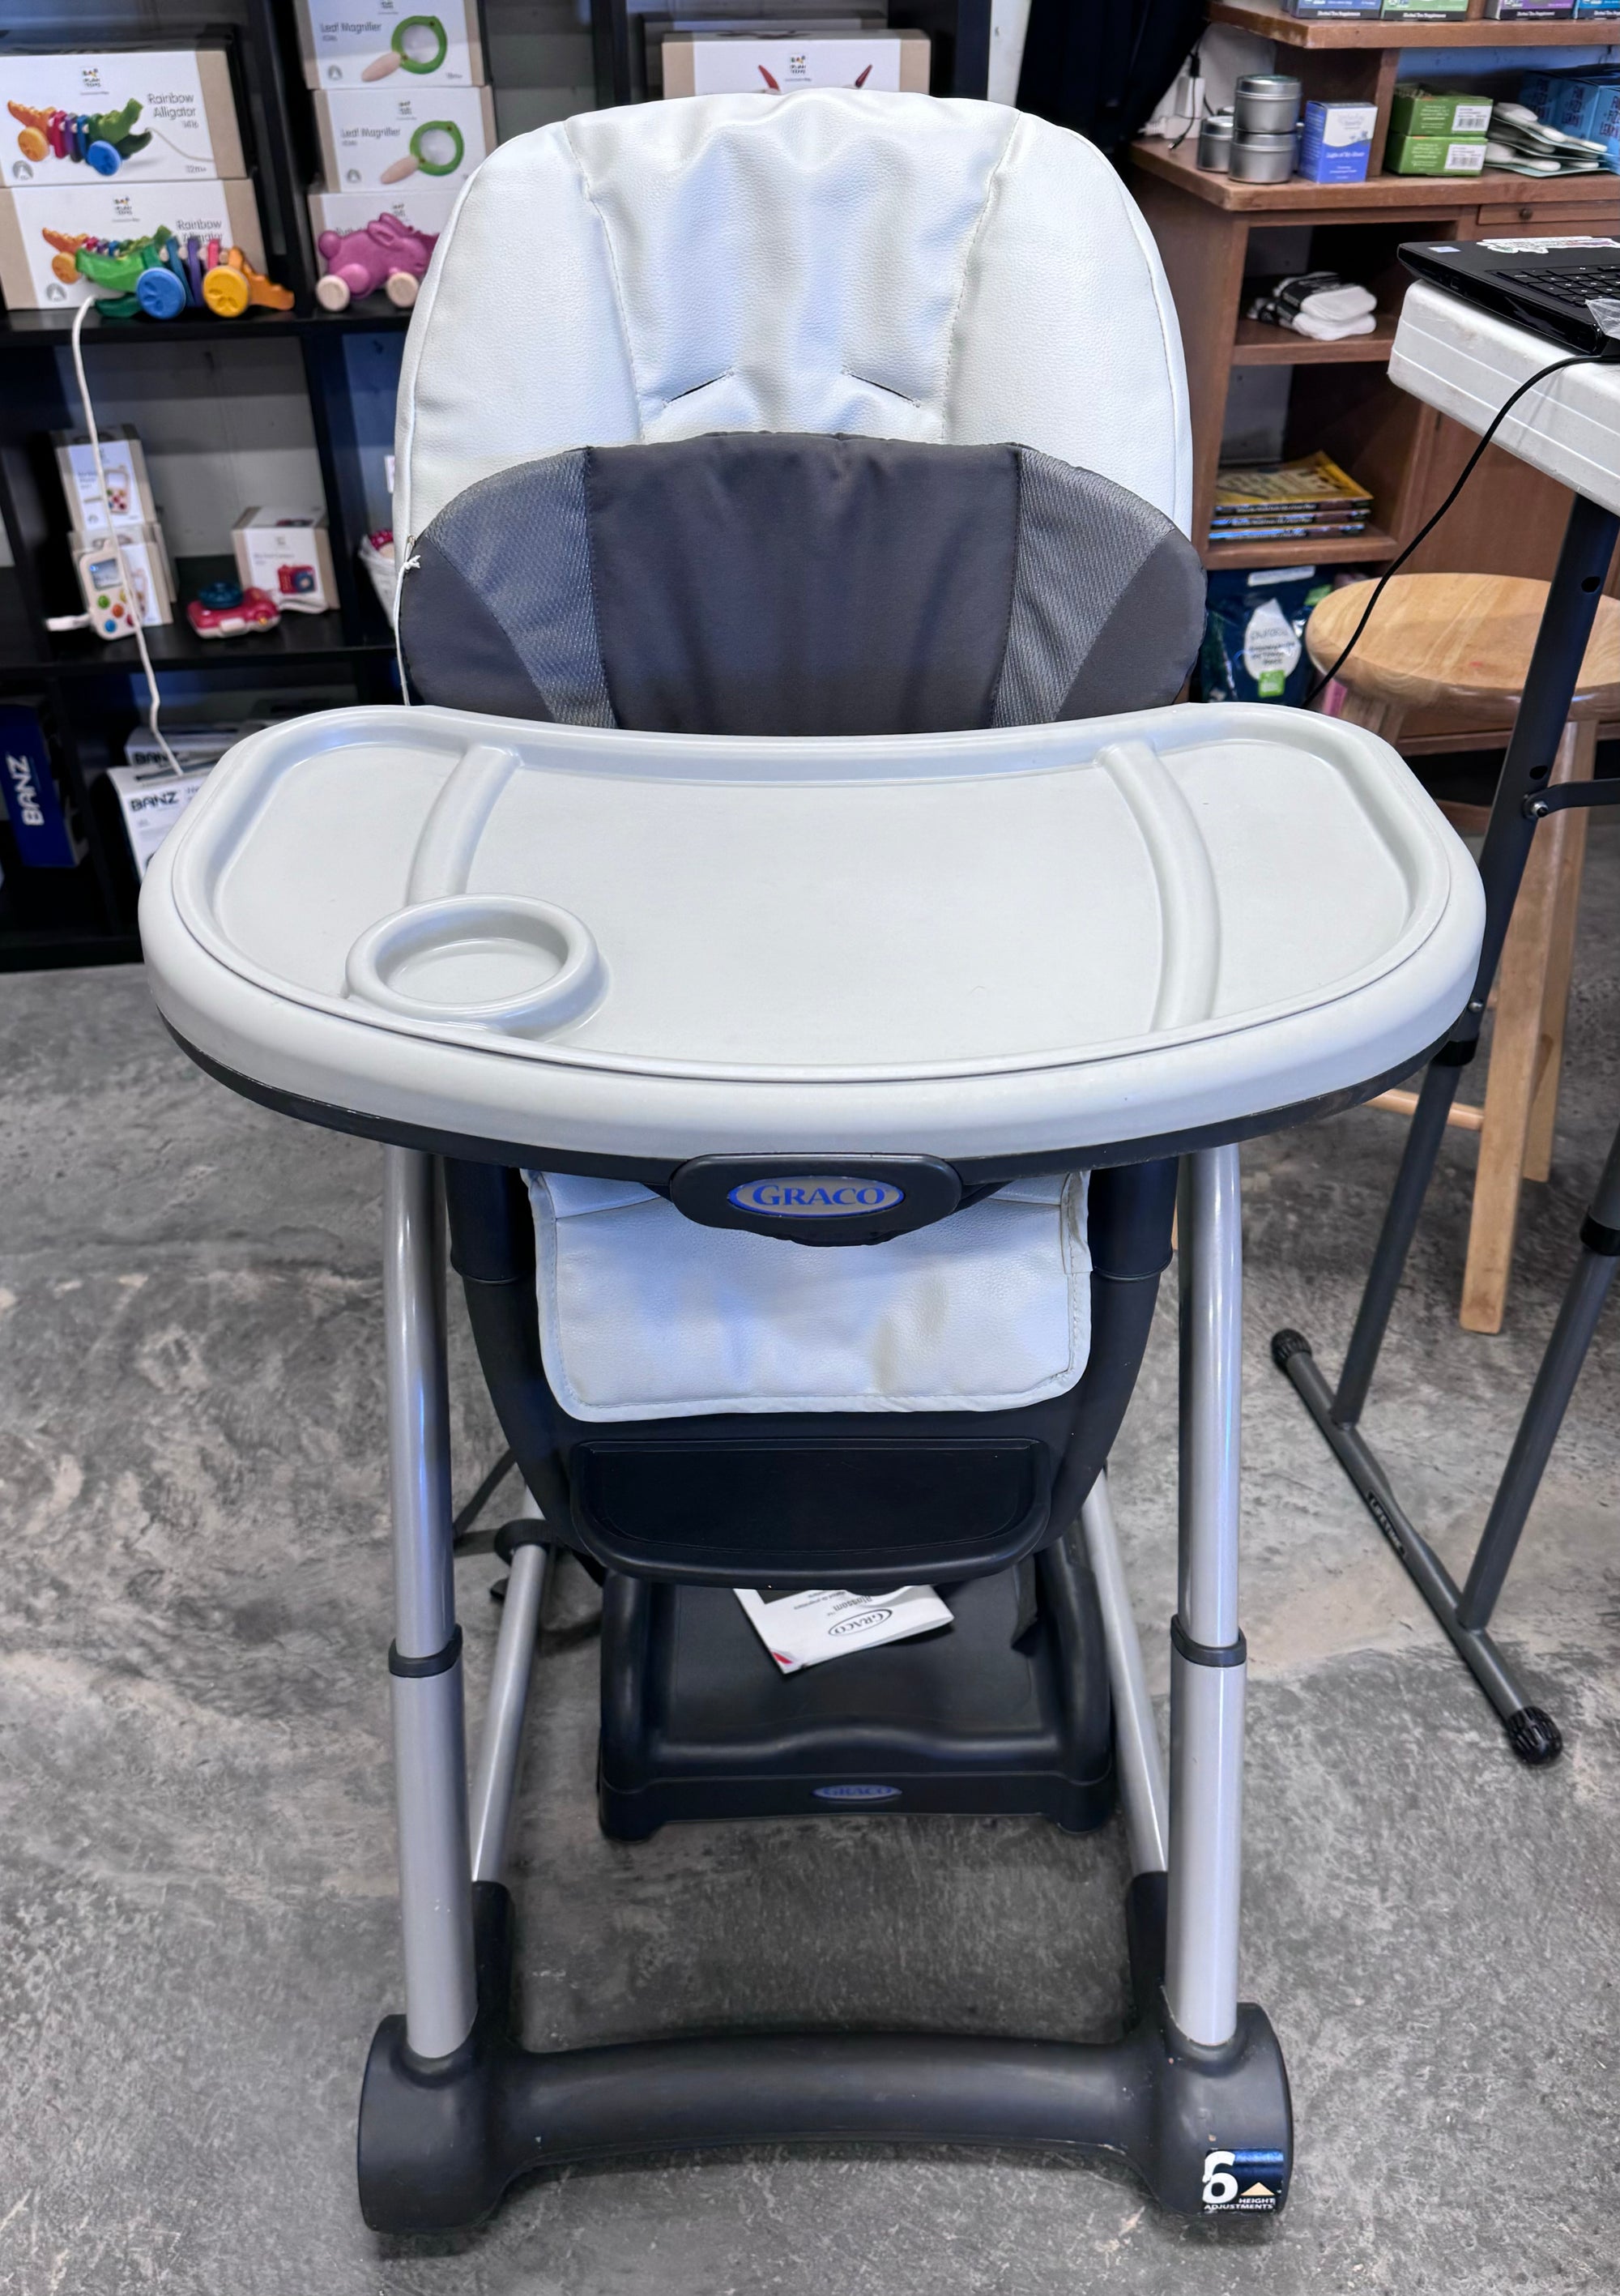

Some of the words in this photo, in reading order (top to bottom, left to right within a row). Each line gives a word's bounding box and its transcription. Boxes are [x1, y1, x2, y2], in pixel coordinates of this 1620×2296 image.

[147, 92, 194, 105] Rainbow
[153, 106, 196, 121] Alligator
[176, 219, 222, 231] Rainbow
[5, 751, 45, 826] BANZ
[130, 790, 179, 813] BANZ
[752, 1184, 885, 1206] GRACO
[833, 1612, 885, 1635] GRACO
[822, 1786, 892, 1797] GRACO
[1201, 2150, 1238, 2204] 6
